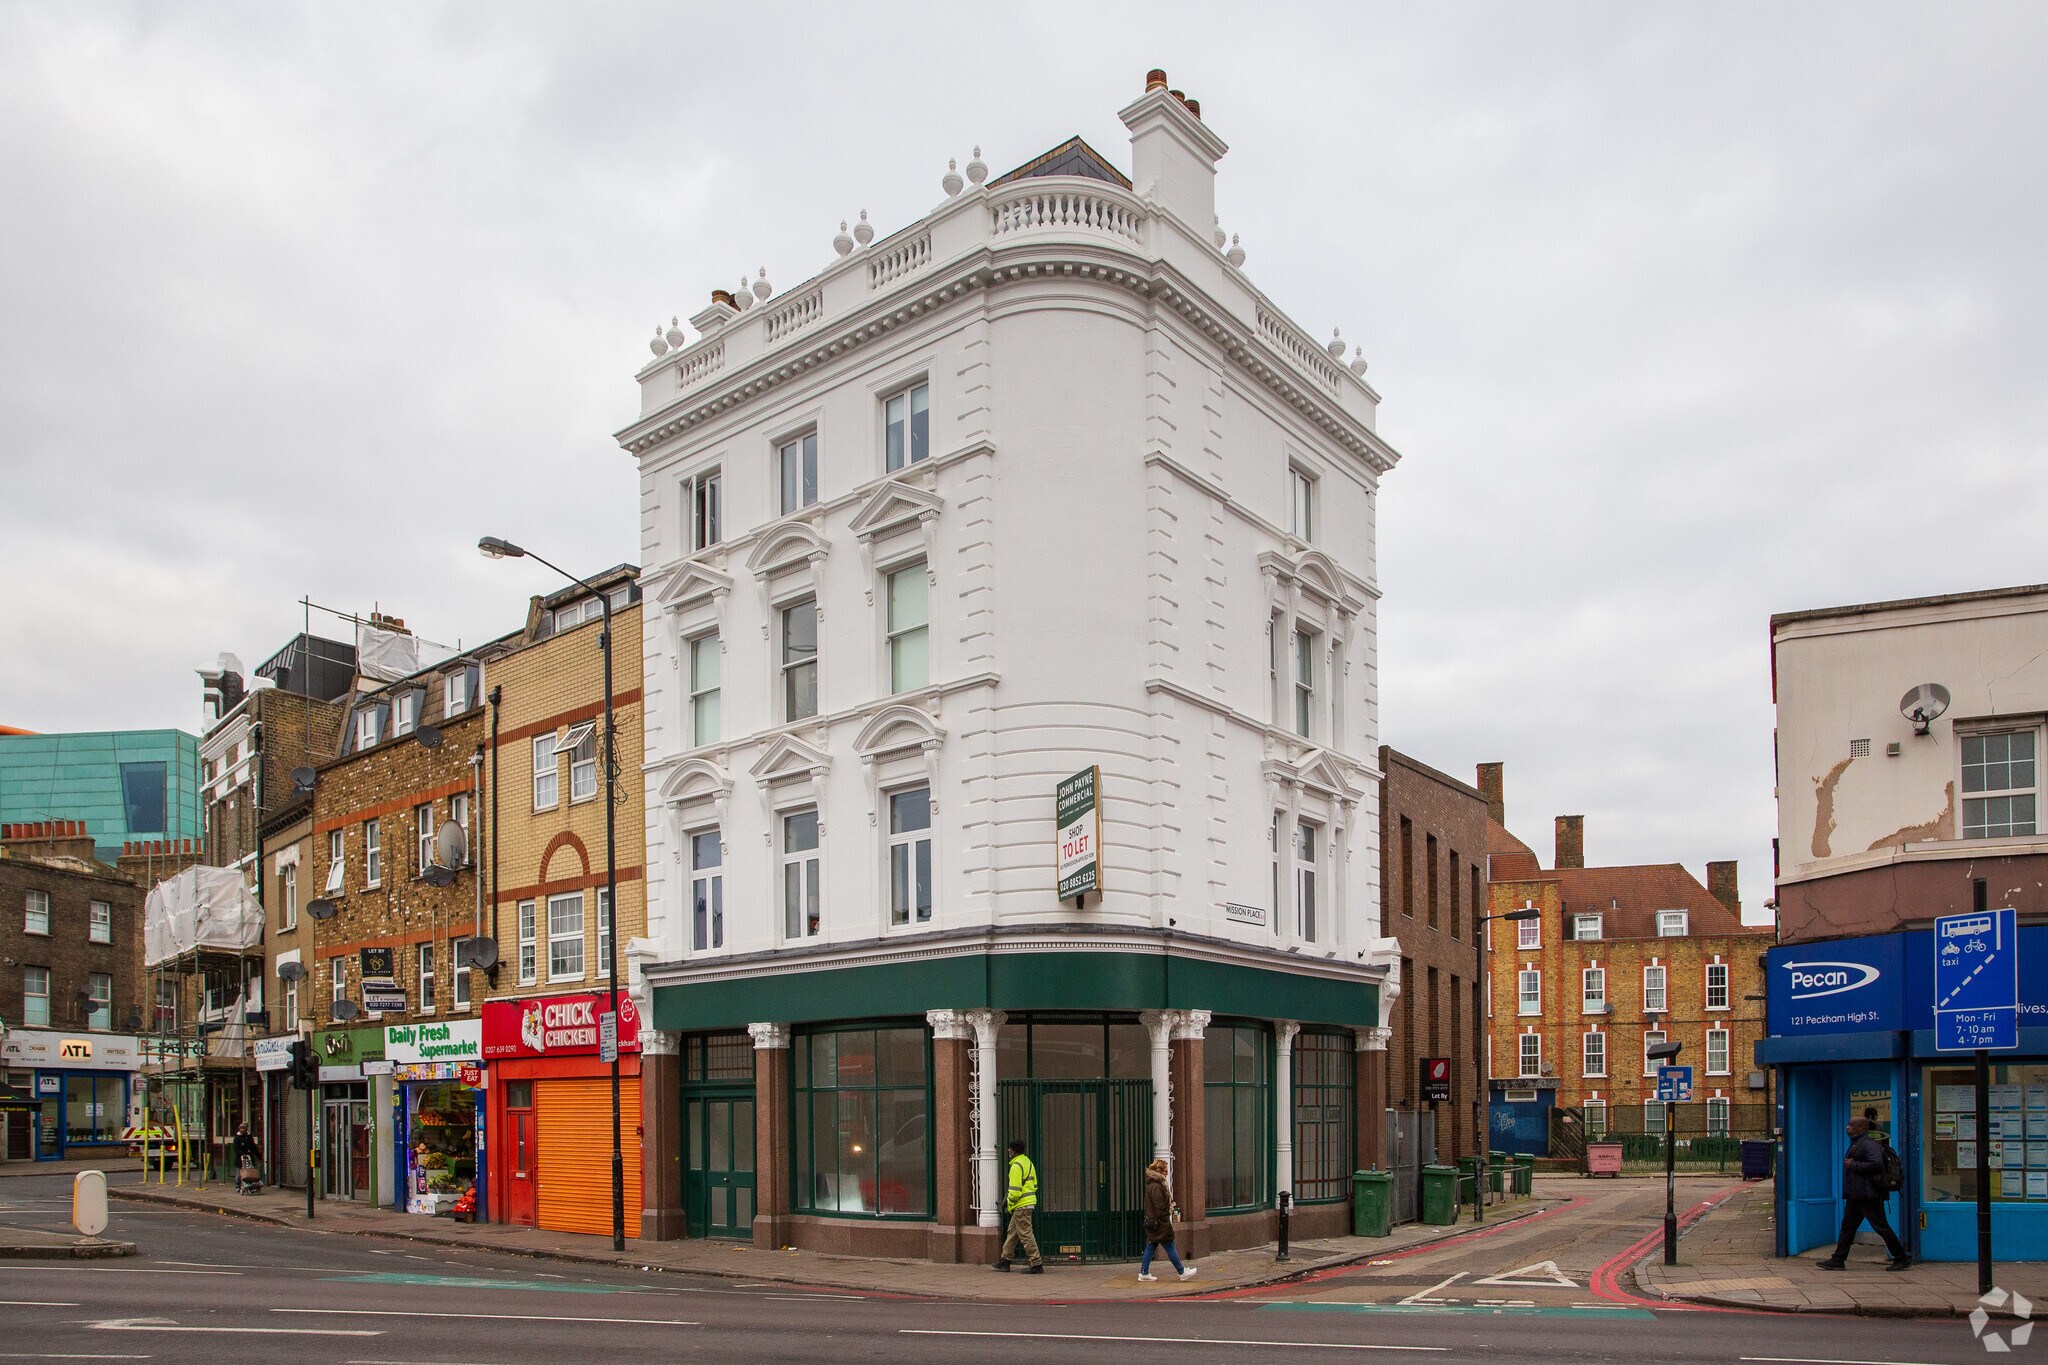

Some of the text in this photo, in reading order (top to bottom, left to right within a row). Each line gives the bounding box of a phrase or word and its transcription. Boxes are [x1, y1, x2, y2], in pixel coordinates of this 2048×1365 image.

[1059, 772, 1093, 799] JOHN PAYNE
[1059, 786, 1093, 811] COMMERCIAL
[1069, 824, 1083, 839] SHOP
[1063, 835, 1089, 859] TO LET
[1060, 870, 1095, 892] 020 8852 6125
[1226, 905, 1246, 916] MISSION
[1247, 909, 1260, 918] PLACE
[1942, 957, 1959, 967] taxi
[1791, 971, 1847, 989] Pecan
[545, 1002, 596, 1027] CHICK
[1791, 1011, 1880, 1025] 121 Peckham High St.
[1956, 1014, 1976, 1022] Mon
[1983, 1012, 1996, 1021] Fri
[389, 1023, 450, 1047] Daily Fresh
[546, 1028, 597, 1047] CHICKEN
[1978, 1036, 1993, 1046] pm
[62, 1045, 91, 1057] ATL
[419, 1040, 477, 1060] Supermarket
